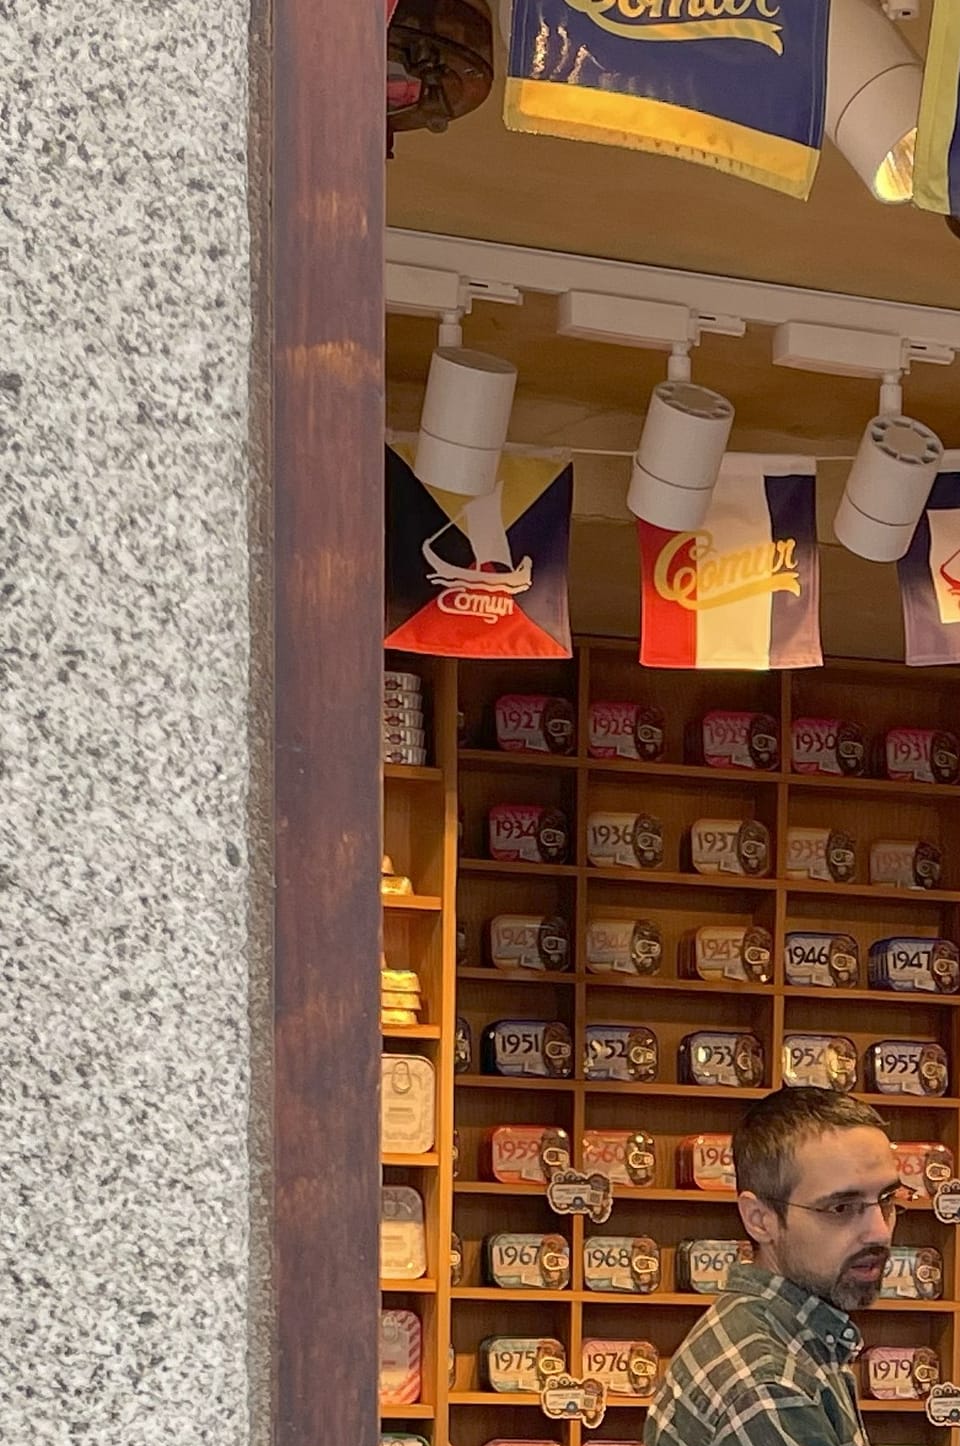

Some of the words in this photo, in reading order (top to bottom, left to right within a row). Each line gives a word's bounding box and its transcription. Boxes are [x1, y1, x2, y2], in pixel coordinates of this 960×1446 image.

[654, 531, 801, 610] Comur
[437, 588, 513, 623] Comur
[795, 733, 837, 753] 1930
[894, 739, 930, 761] 1931
[591, 824, 633, 846] 1936
[698, 831, 736, 852] 1937
[788, 945, 828, 965] 1946
[891, 950, 931, 970] 1947
[501, 1034, 540, 1054] 1951
[879, 1052, 920, 1073] 1955
[496, 1139, 541, 1161] 1959
[700, 1146, 732, 1165] 196
[498, 1247, 540, 1266] 1967
[587, 1247, 630, 1268] 1968
[881, 1256, 915, 1276] 971
[494, 1350, 537, 1371] 1975
[586, 1351, 629, 1373] 1976
[872, 1358, 914, 1380] 1979
